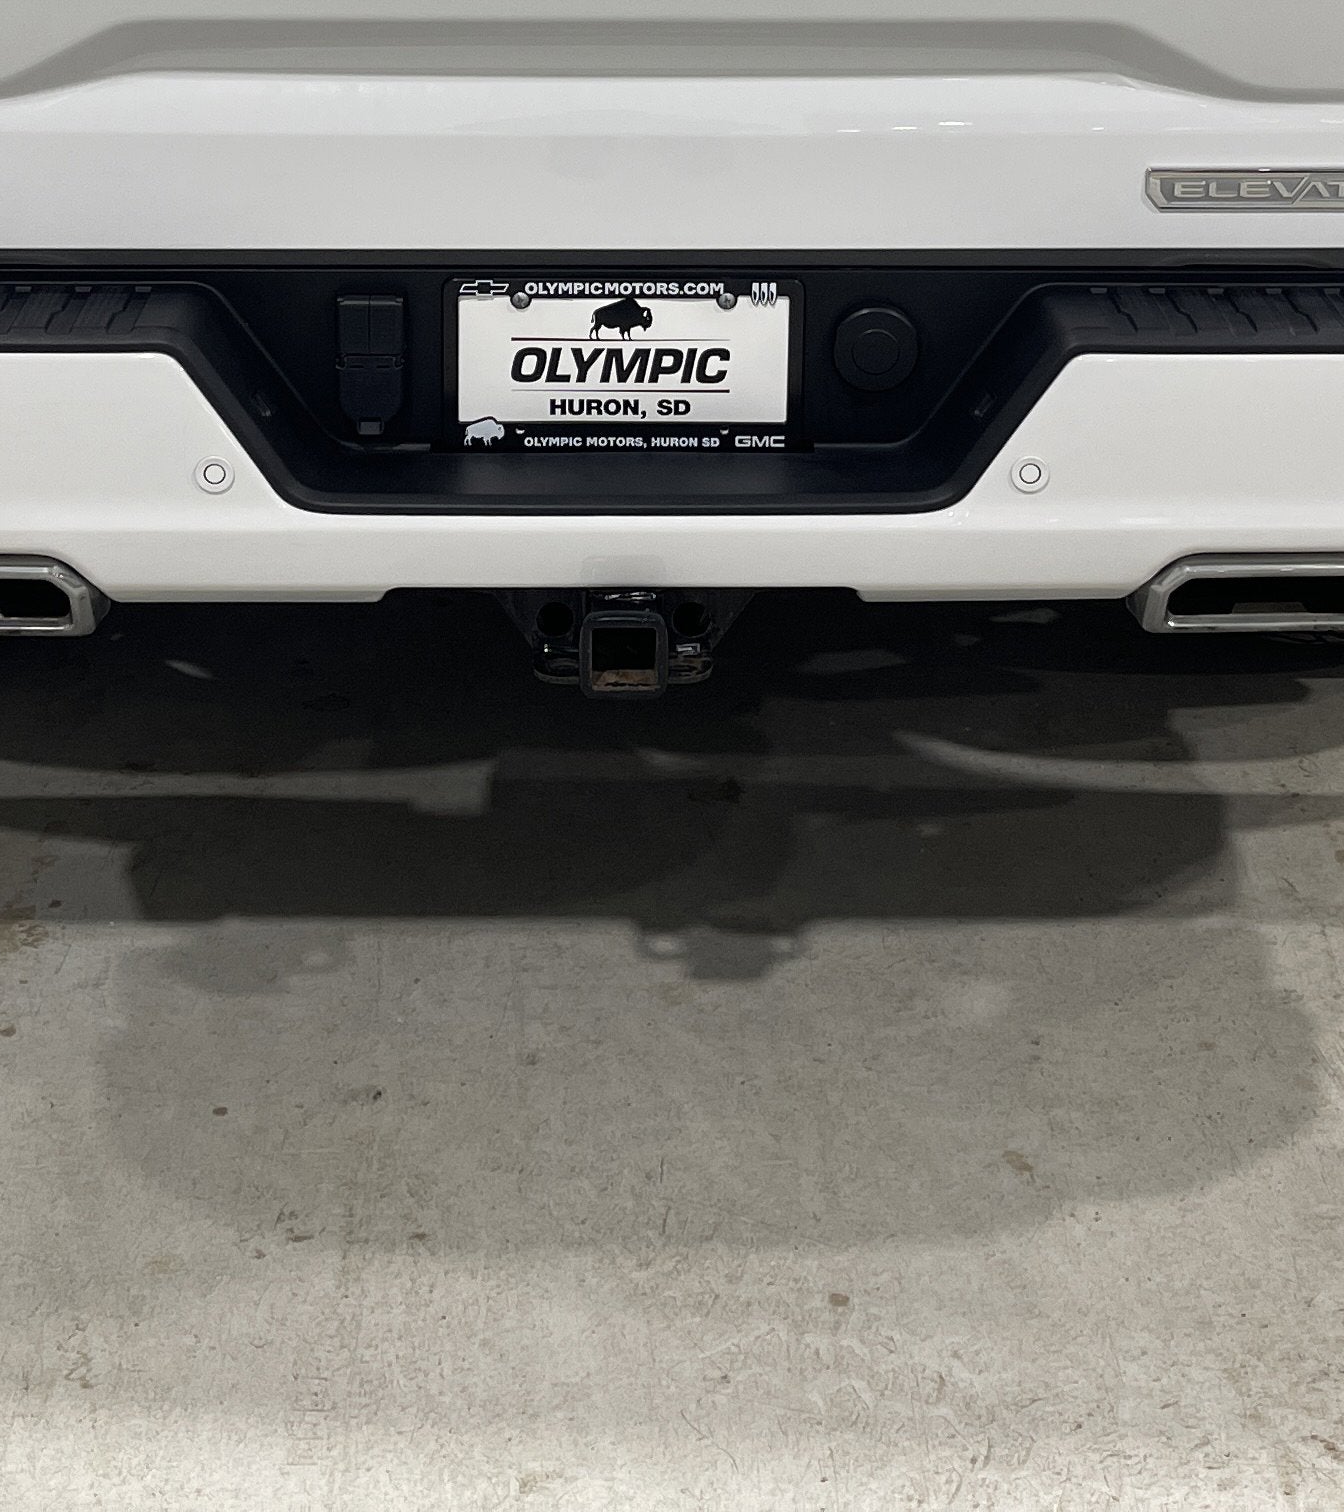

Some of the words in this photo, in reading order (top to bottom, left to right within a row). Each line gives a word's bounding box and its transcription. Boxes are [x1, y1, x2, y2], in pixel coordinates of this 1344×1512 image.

[524, 282, 725, 296] OLYMPICMOTORS.COM
[511, 347, 731, 384] OLYMPIC
[549, 399, 647, 419] HURON,
[656, 399, 691, 416] SD
[524, 436, 583, 448] OLYMPIC
[586, 436, 648, 449] MOTORS,
[651, 437, 698, 448] HURON
[702, 437, 721, 448] SD
[735, 435, 786, 448] GMC
